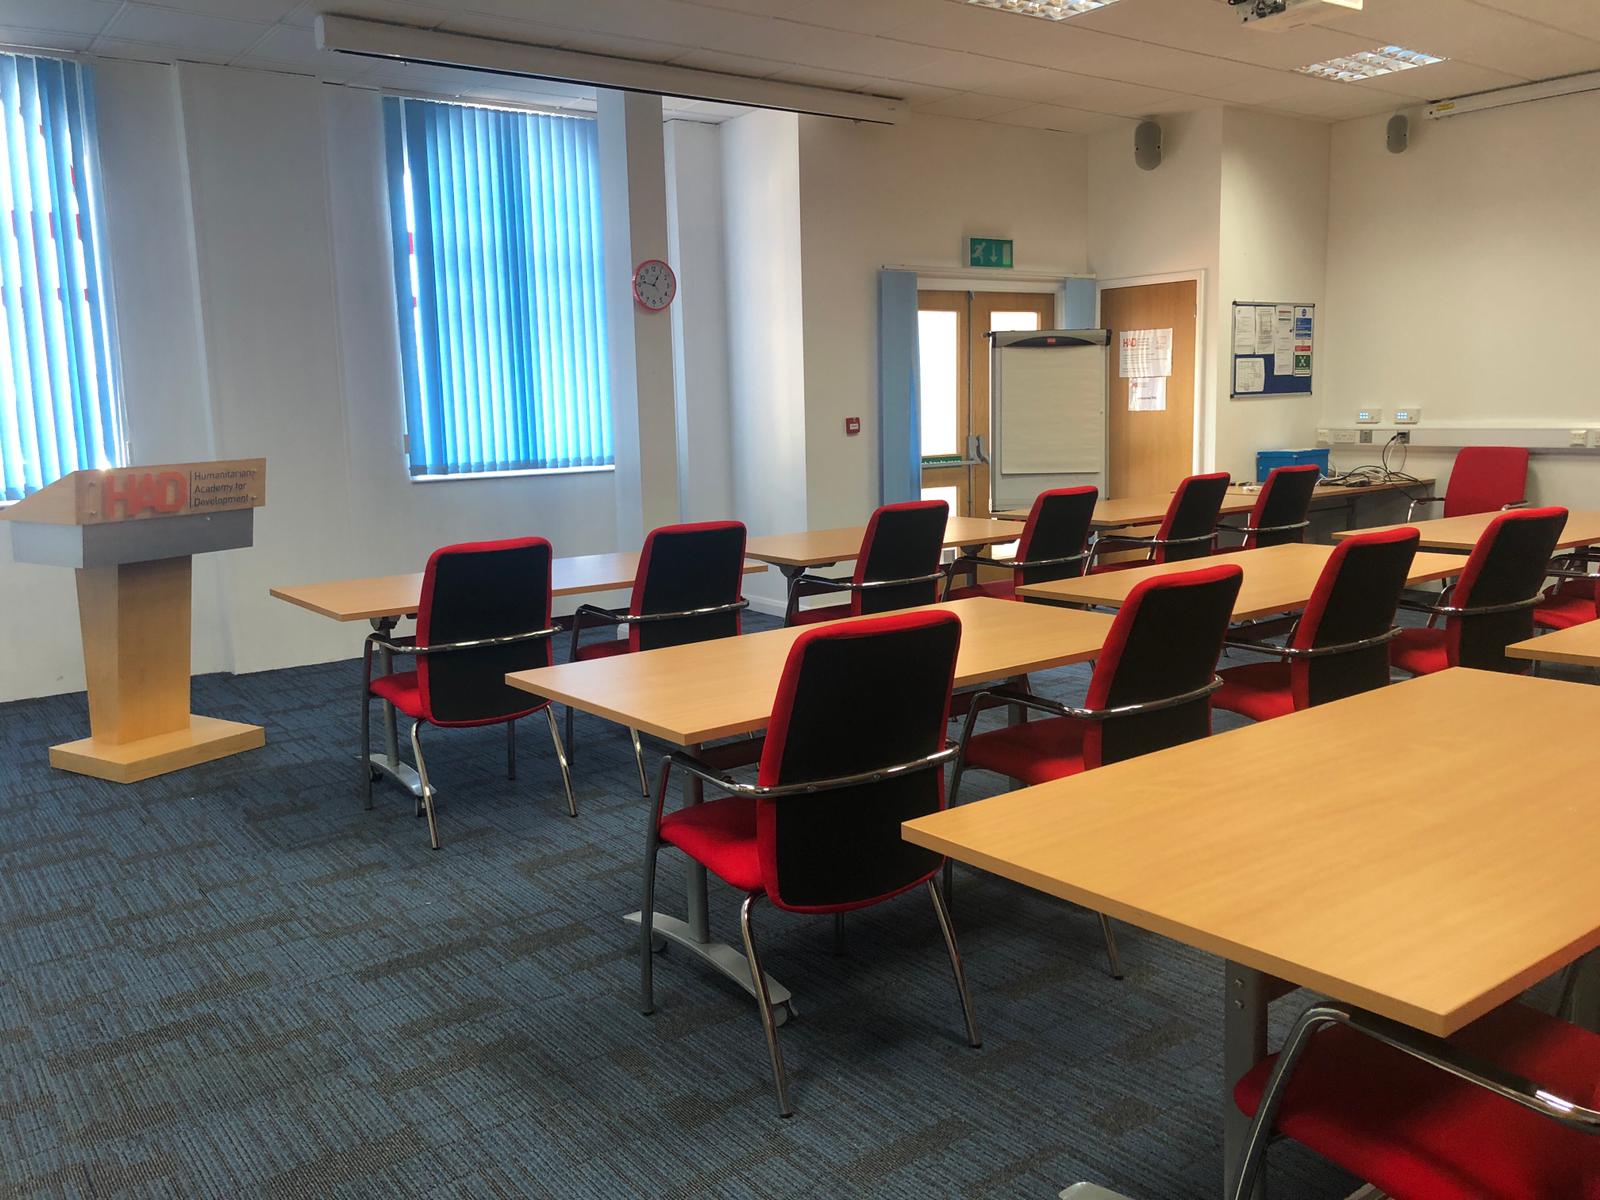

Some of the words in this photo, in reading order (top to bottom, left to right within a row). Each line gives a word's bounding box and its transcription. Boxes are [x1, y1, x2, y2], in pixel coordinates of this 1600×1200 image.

[194, 470, 252, 481] Humanitarian
[194, 483, 234, 494] Academy
[235, 482, 247, 490] for
[104, 471, 187, 518] HAD
[194, 494, 249, 507] Development
